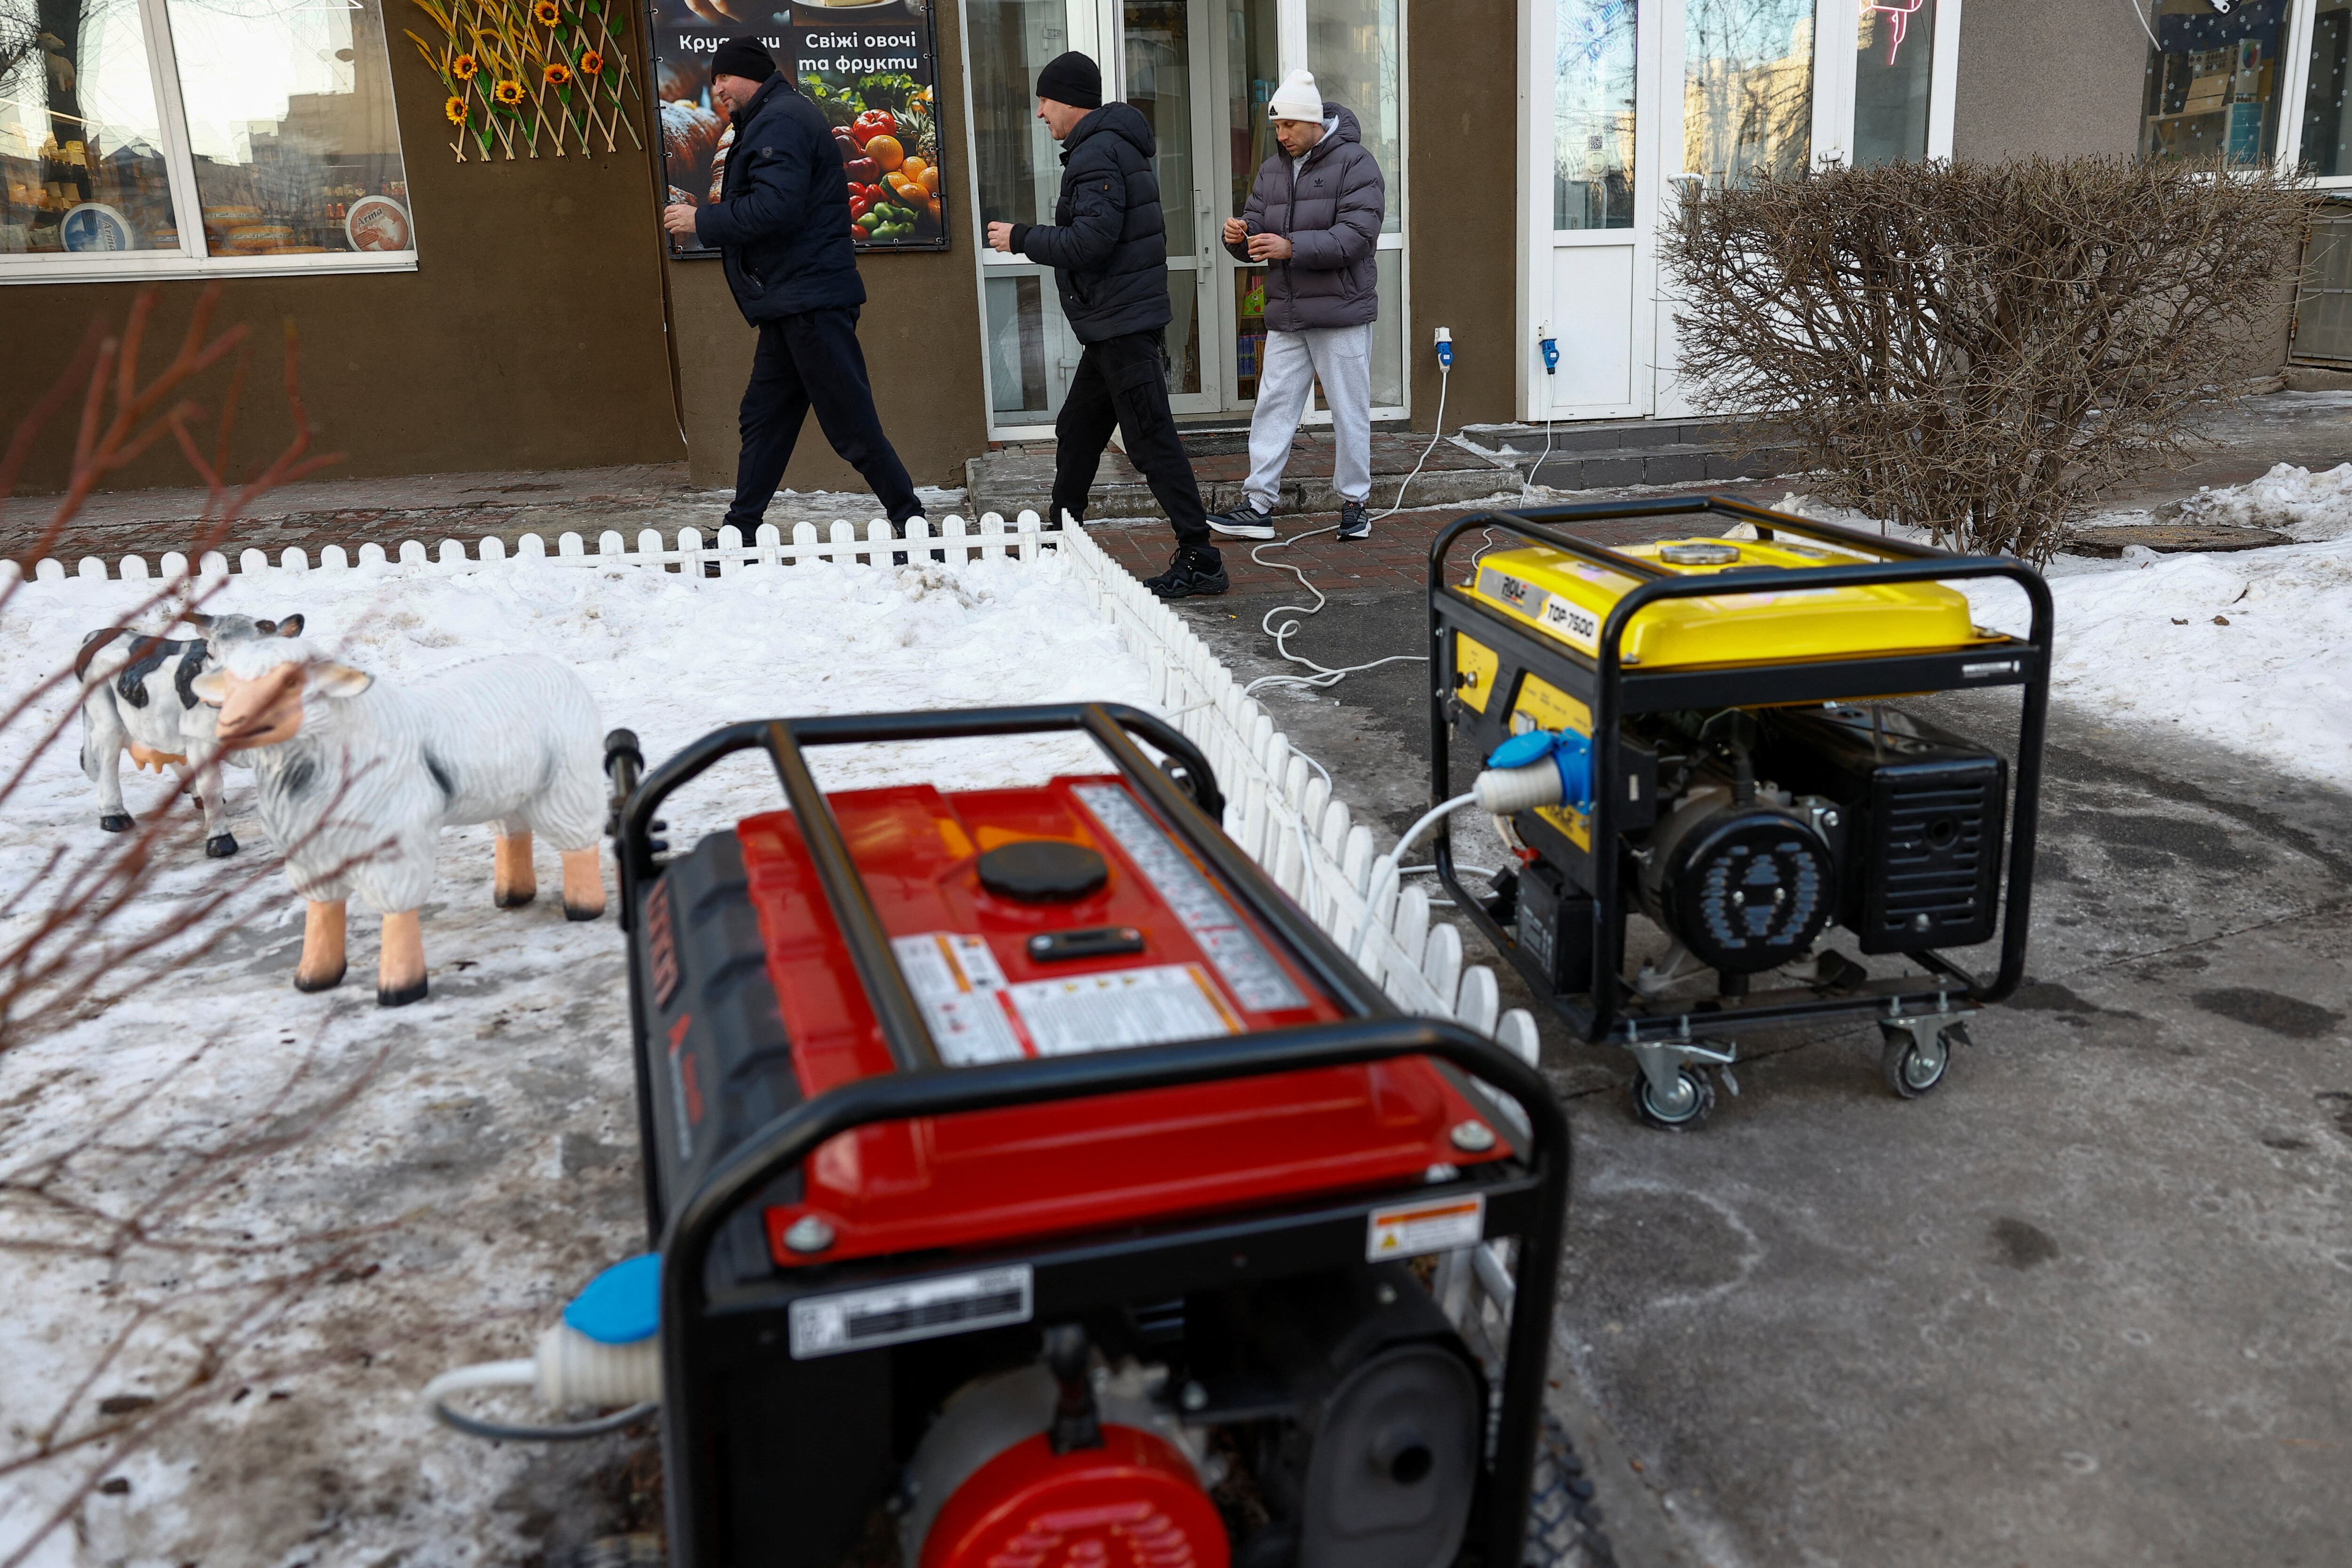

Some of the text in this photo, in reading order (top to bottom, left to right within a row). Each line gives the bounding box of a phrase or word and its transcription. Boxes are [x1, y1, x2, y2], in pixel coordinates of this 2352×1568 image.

[679, 35, 780, 53] Круни
[805, 31, 916, 48] Свіжі овочі
[799, 55, 918, 74] та фрукти
[358, 207, 383, 228] Arina
[102, 220, 117, 251] Arina
[1548, 604, 1594, 637] TOP-7500
